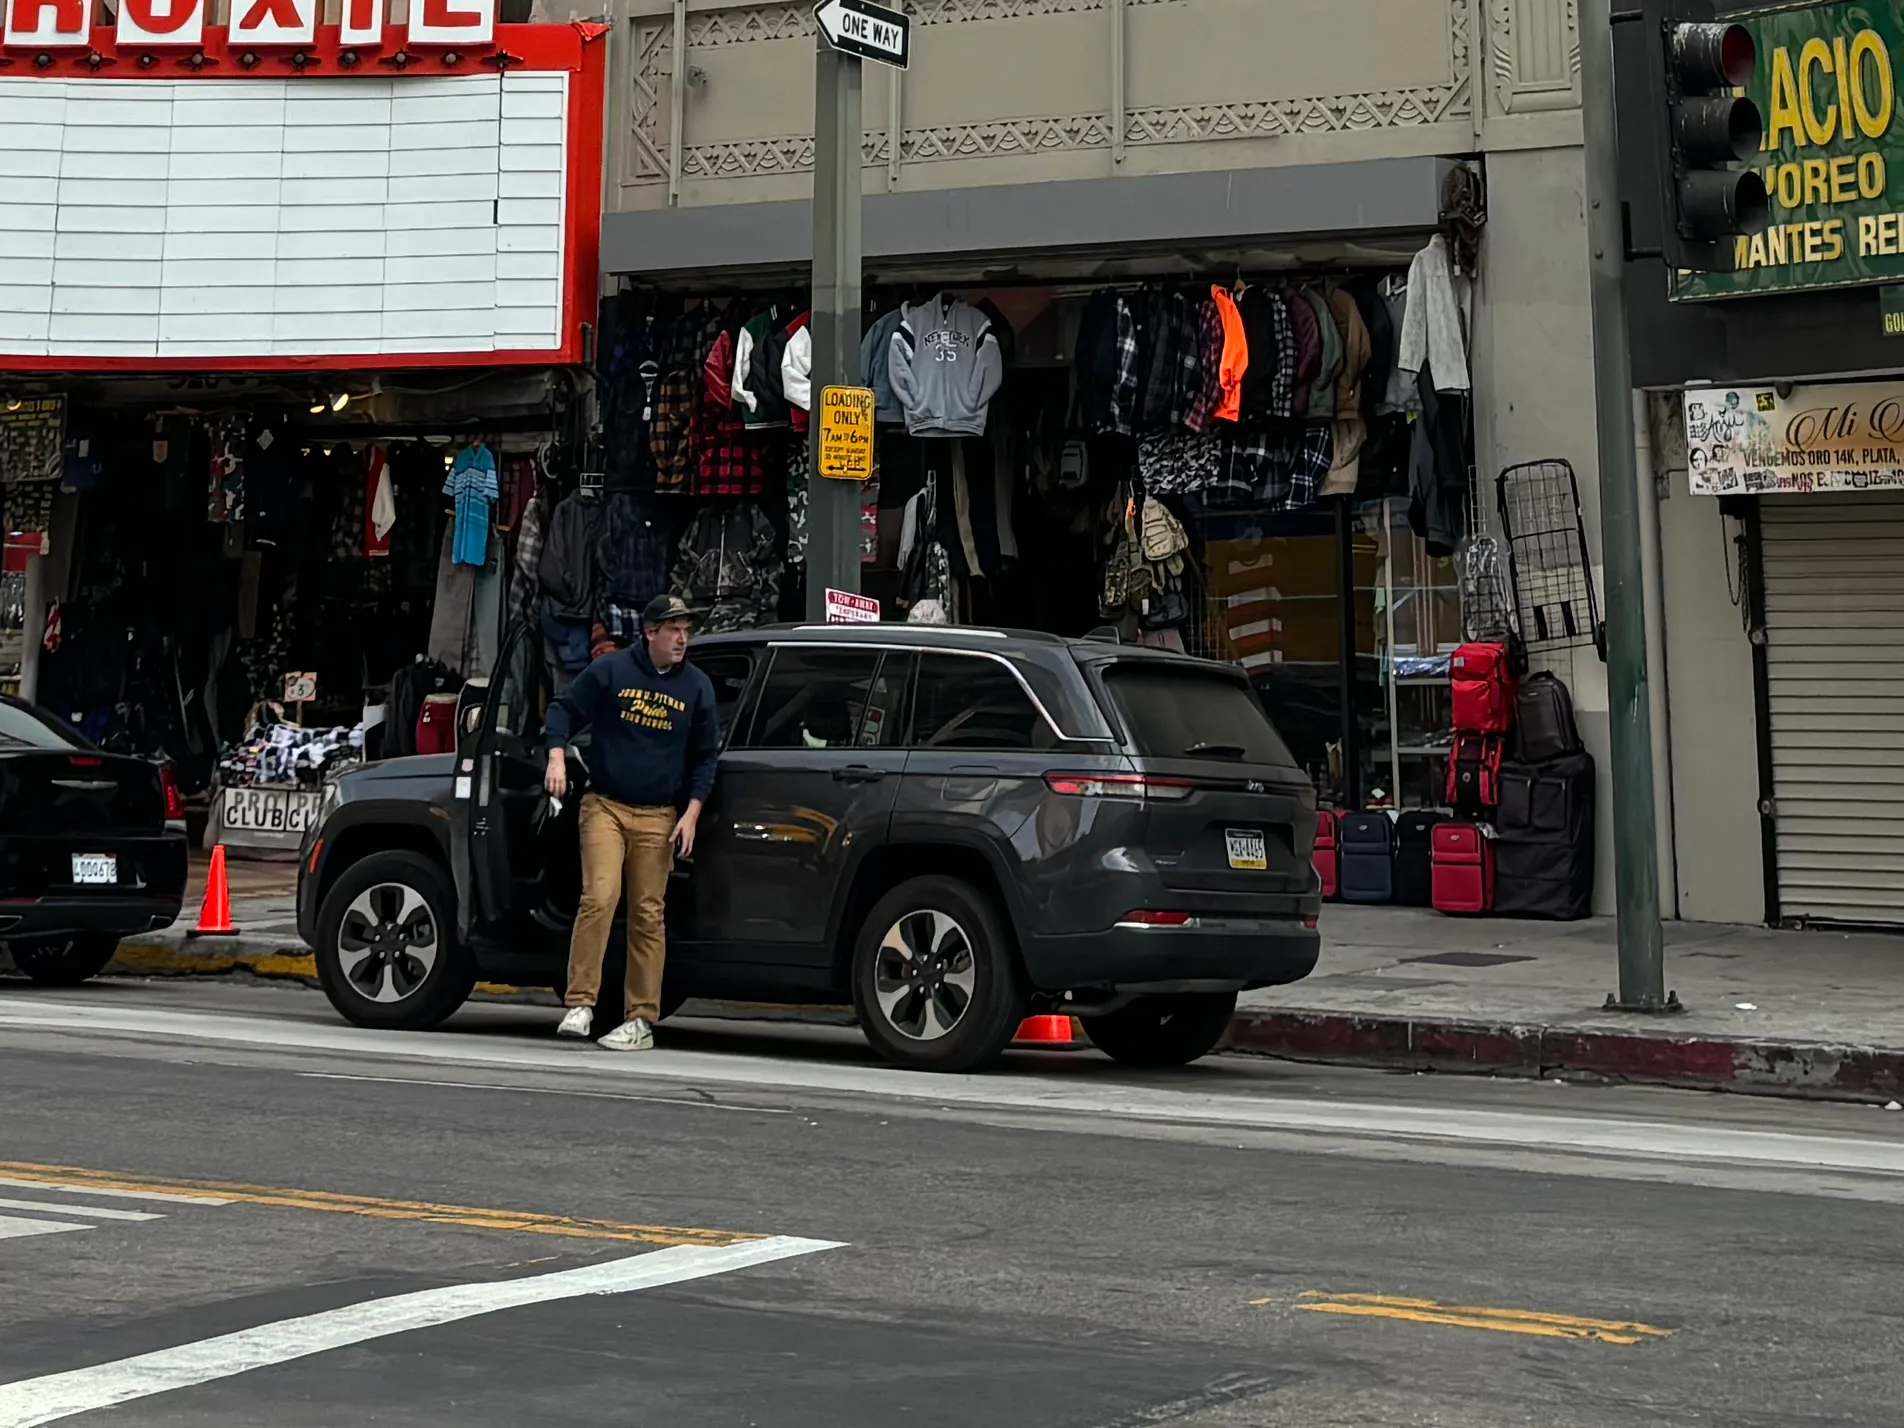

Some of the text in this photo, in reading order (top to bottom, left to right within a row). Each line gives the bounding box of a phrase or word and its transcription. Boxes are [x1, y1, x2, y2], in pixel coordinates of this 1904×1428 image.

[842, 12, 900, 50] ONE WAY
[935, 344, 957, 362] 35
[825, 392, 871, 409] LOADING
[834, 410, 861, 425] ONLY
[1786, 402, 1858, 451] Mi
[1808, 449, 1830, 465] ORO
[1834, 448, 1859, 466] 14K,
[1863, 447, 1901, 466] PLATA,
[234, 791, 278, 812] PRO
[226, 805, 283, 828] CLUB
